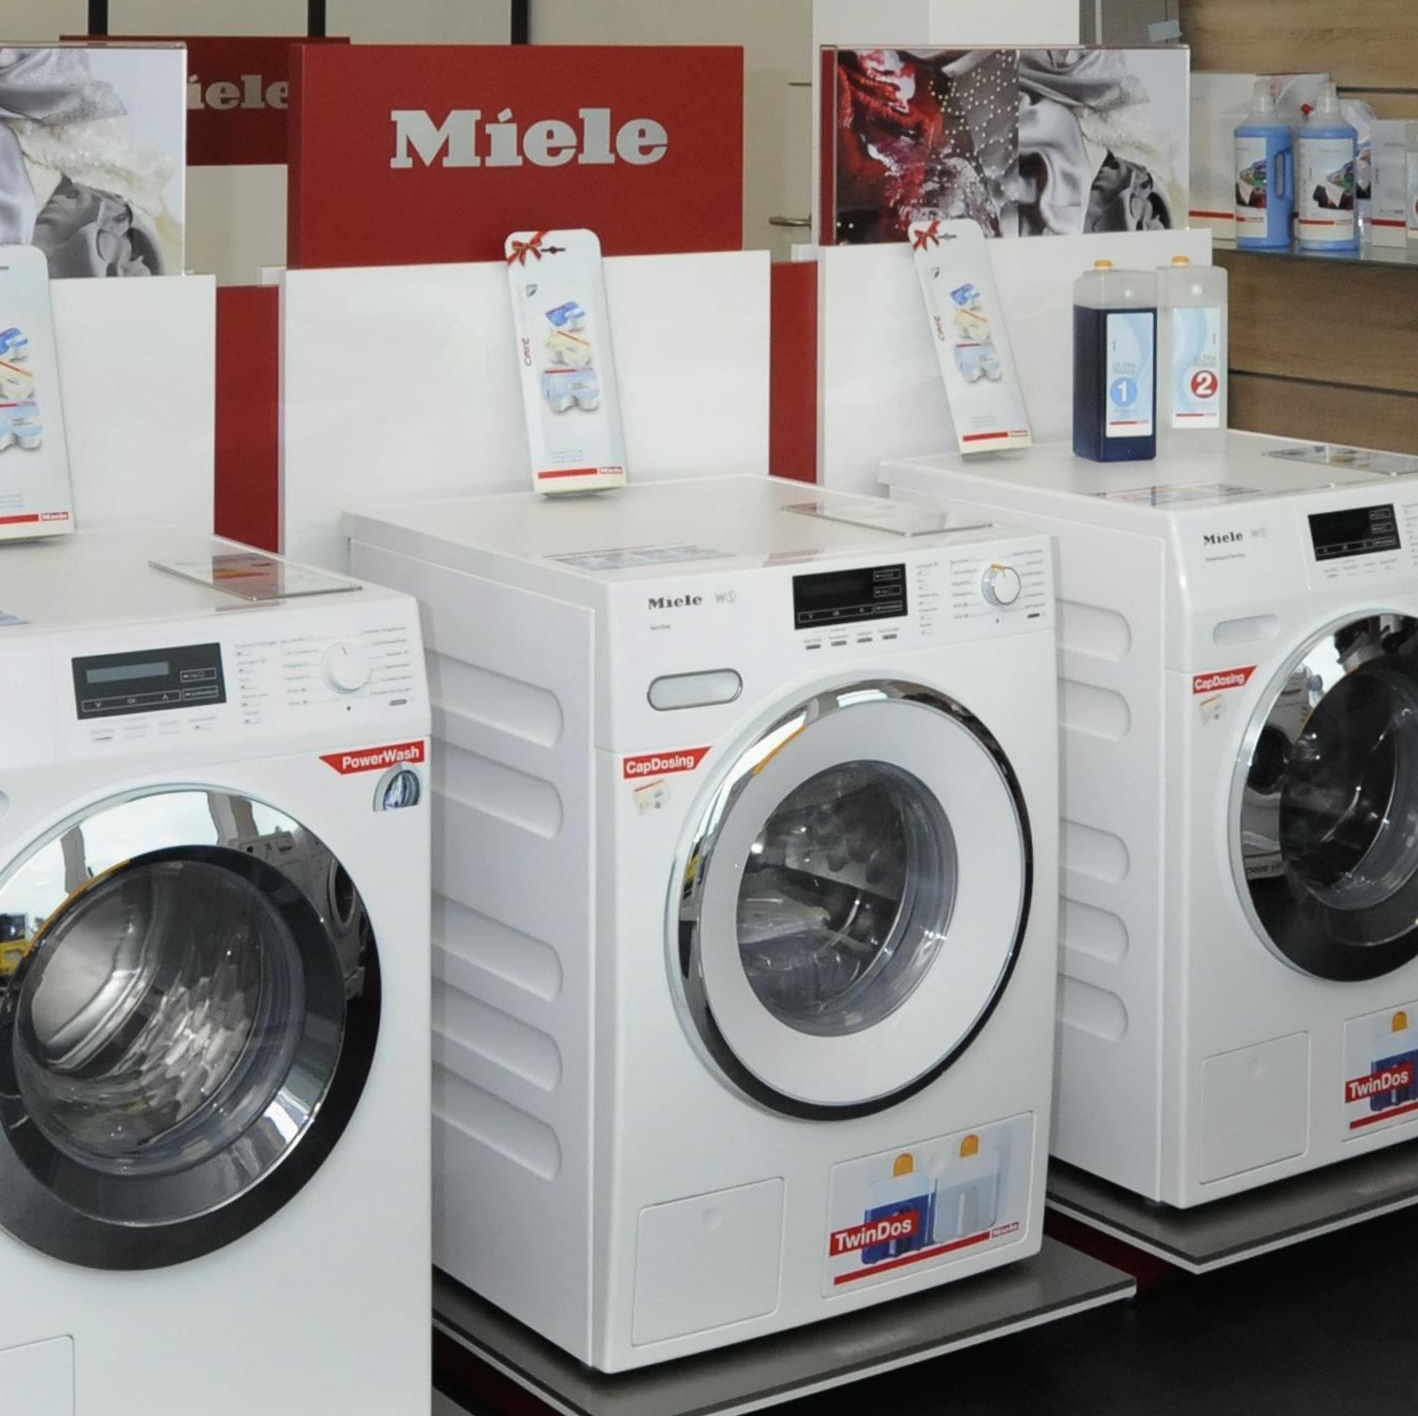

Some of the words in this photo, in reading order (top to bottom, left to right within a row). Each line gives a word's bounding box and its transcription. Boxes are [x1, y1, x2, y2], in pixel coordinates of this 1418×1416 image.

[186, 75, 289, 110] iele
[390, 108, 668, 169] Miele
[1117, 380, 1128, 402] 1
[1195, 372, 1213, 396] 2
[1203, 531, 1244, 546] Miele
[647, 594, 703, 611] Miele
[1194, 673, 1244, 691] CapDosing
[342, 746, 420, 770] PowerWash
[626, 755, 694, 775] CapDosing
[1348, 1070, 1410, 1100] TwinDos
[835, 1217, 912, 1252] TwinDos
